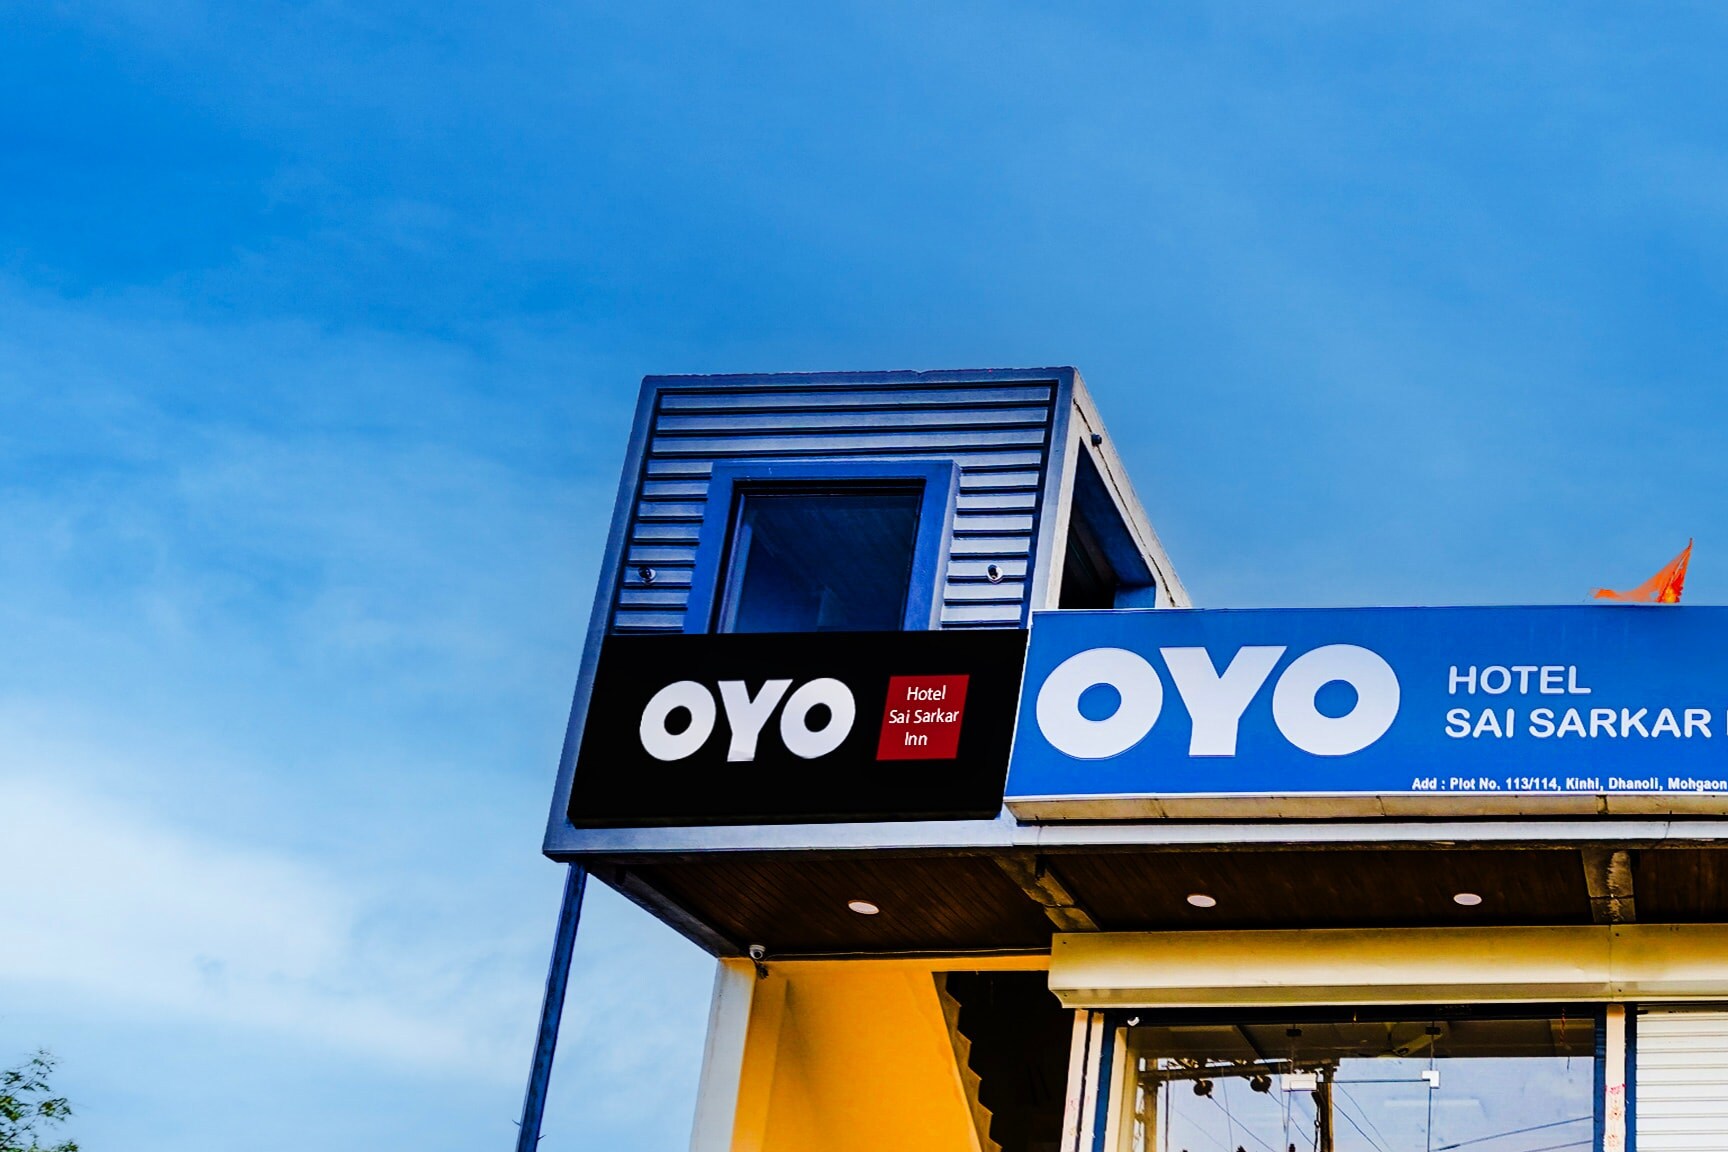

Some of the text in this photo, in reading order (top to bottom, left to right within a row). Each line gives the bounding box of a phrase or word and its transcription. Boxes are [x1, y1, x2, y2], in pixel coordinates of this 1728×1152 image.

[1449, 665, 1592, 695] HOTEL
[906, 684, 947, 701] Hotel
[1036, 643, 1401, 760] OYO
[639, 677, 856, 762] OYO
[888, 707, 960, 724] Sai Sarkar
[1445, 708, 1515, 738] SAI
[1528, 708, 1712, 738] SARKAR
[904, 731, 928, 746] Inn
[1411, 777, 1438, 791] Add
[1450, 777, 1476, 791] Plot
[1479, 777, 1501, 791] No.
[1505, 777, 1562, 792] 113/114,
[1566, 777, 1604, 792] Kinhi,
[1608, 777, 1664, 792] Dhanoli,
[1667, 778, 1728, 792] Mohgaon
